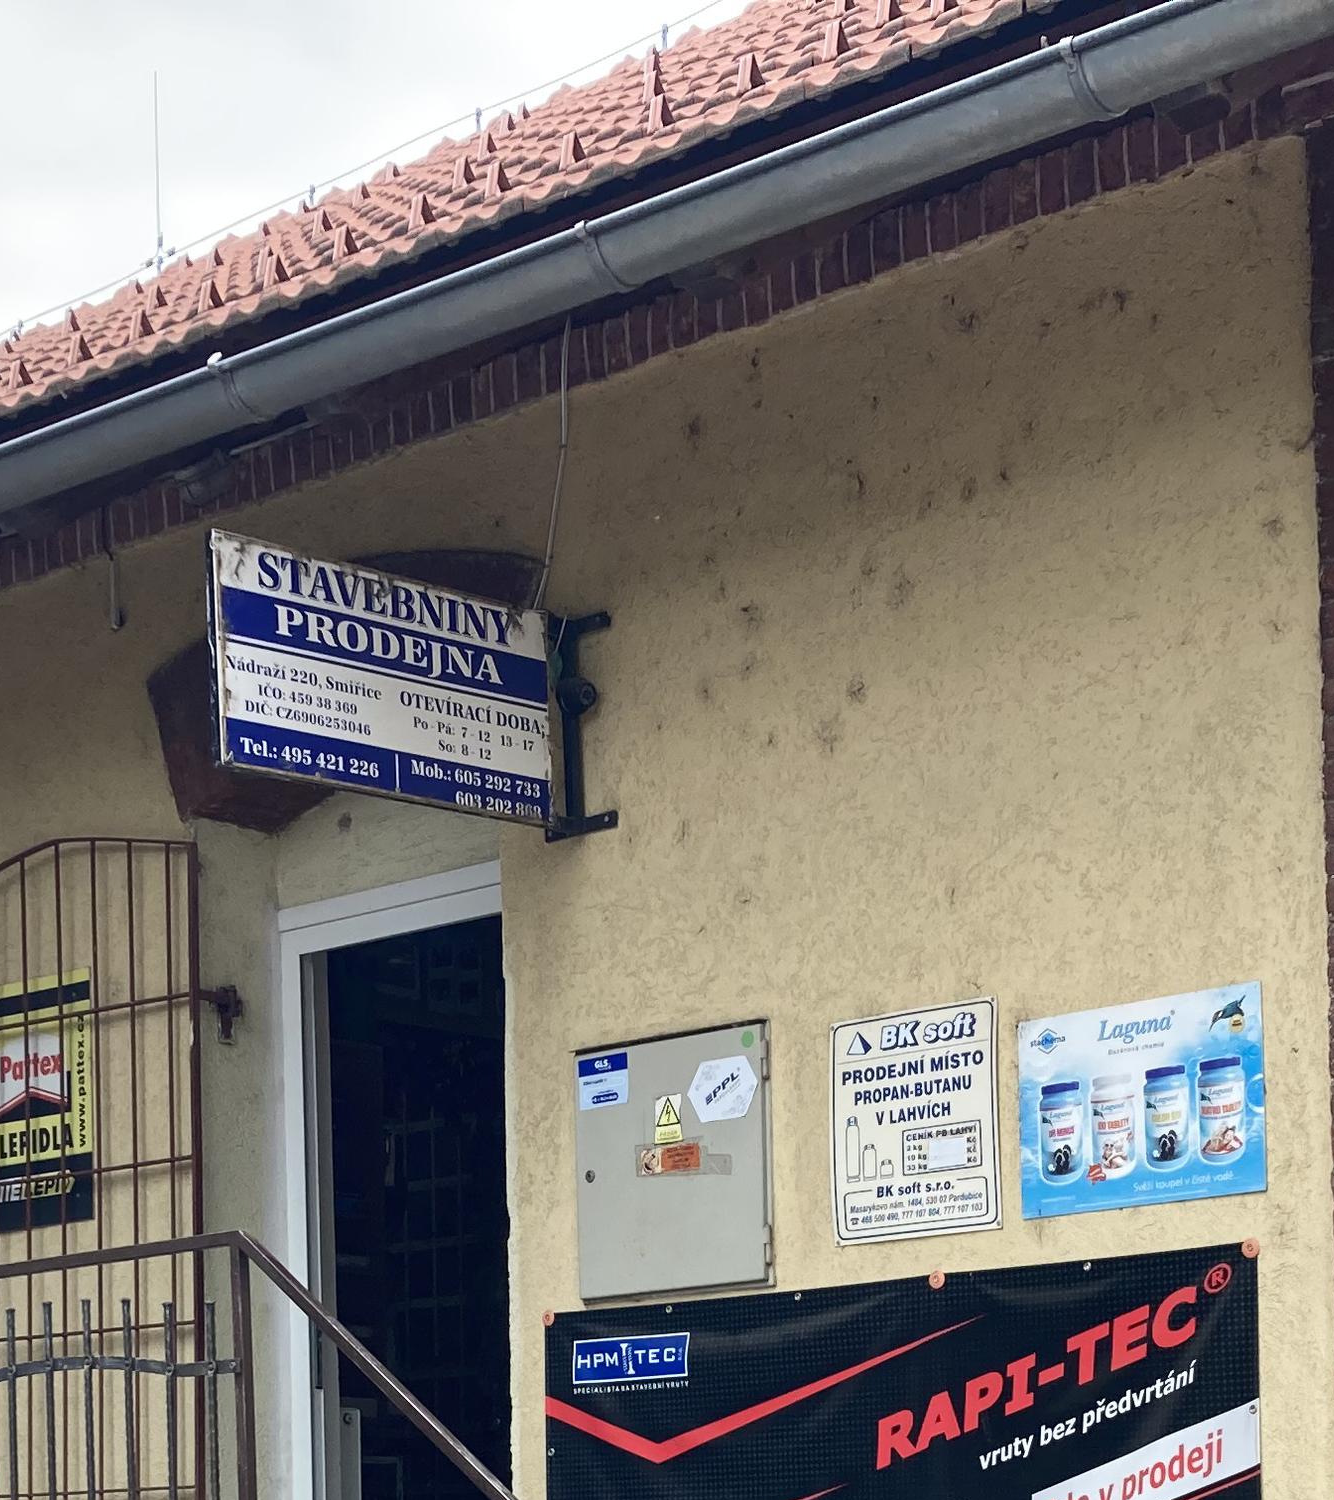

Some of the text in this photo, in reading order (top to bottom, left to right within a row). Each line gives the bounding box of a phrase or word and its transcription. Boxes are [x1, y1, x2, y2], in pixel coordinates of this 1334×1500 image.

[257, 552, 516, 648] STAVEBNINY
[273, 603, 504, 686] PRODEJNA
[225, 655, 382, 700] Nádraží 220, Smiřice
[245, 700, 273, 717] DIČ:
[258, 682, 358, 715] IČO: 459 38 369
[400, 691, 492, 724] OTEVÍRACÍ
[413, 716, 428, 730] Po
[461, 727, 467, 738] 7
[478, 730, 491, 743] 12
[501, 735, 513, 747] 13
[523, 739, 534, 751] 17
[438, 739, 492, 760] So: 8 12
[240, 736, 379, 778] Tel.: 495 421 226
[410, 759, 541, 799] Mob.: 605 292 733
[486, 796, 512, 814] 202
[880, 1012, 975, 1051] BK soft
[1097, 1015, 1173, 1044] Laguna
[0, 1052, 63, 1083] Patex
[841, 1050, 984, 1085] PRODEJNÍ MÍSTO
[712, 1072, 739, 1098] PPL
[854, 1074, 972, 1106] PROPAN-BUTANU
[875, 1100, 951, 1126] V LAHVÍCH
[906, 1130, 933, 1142] CENÍK
[877, 1181, 955, 1198] BK soft s.r.o.
[577, 1347, 676, 1369] HPM TEC
[875, 1285, 1198, 1470] RAPI-TEC
[979, 1361, 1197, 1472] vruty bez předvrtání
